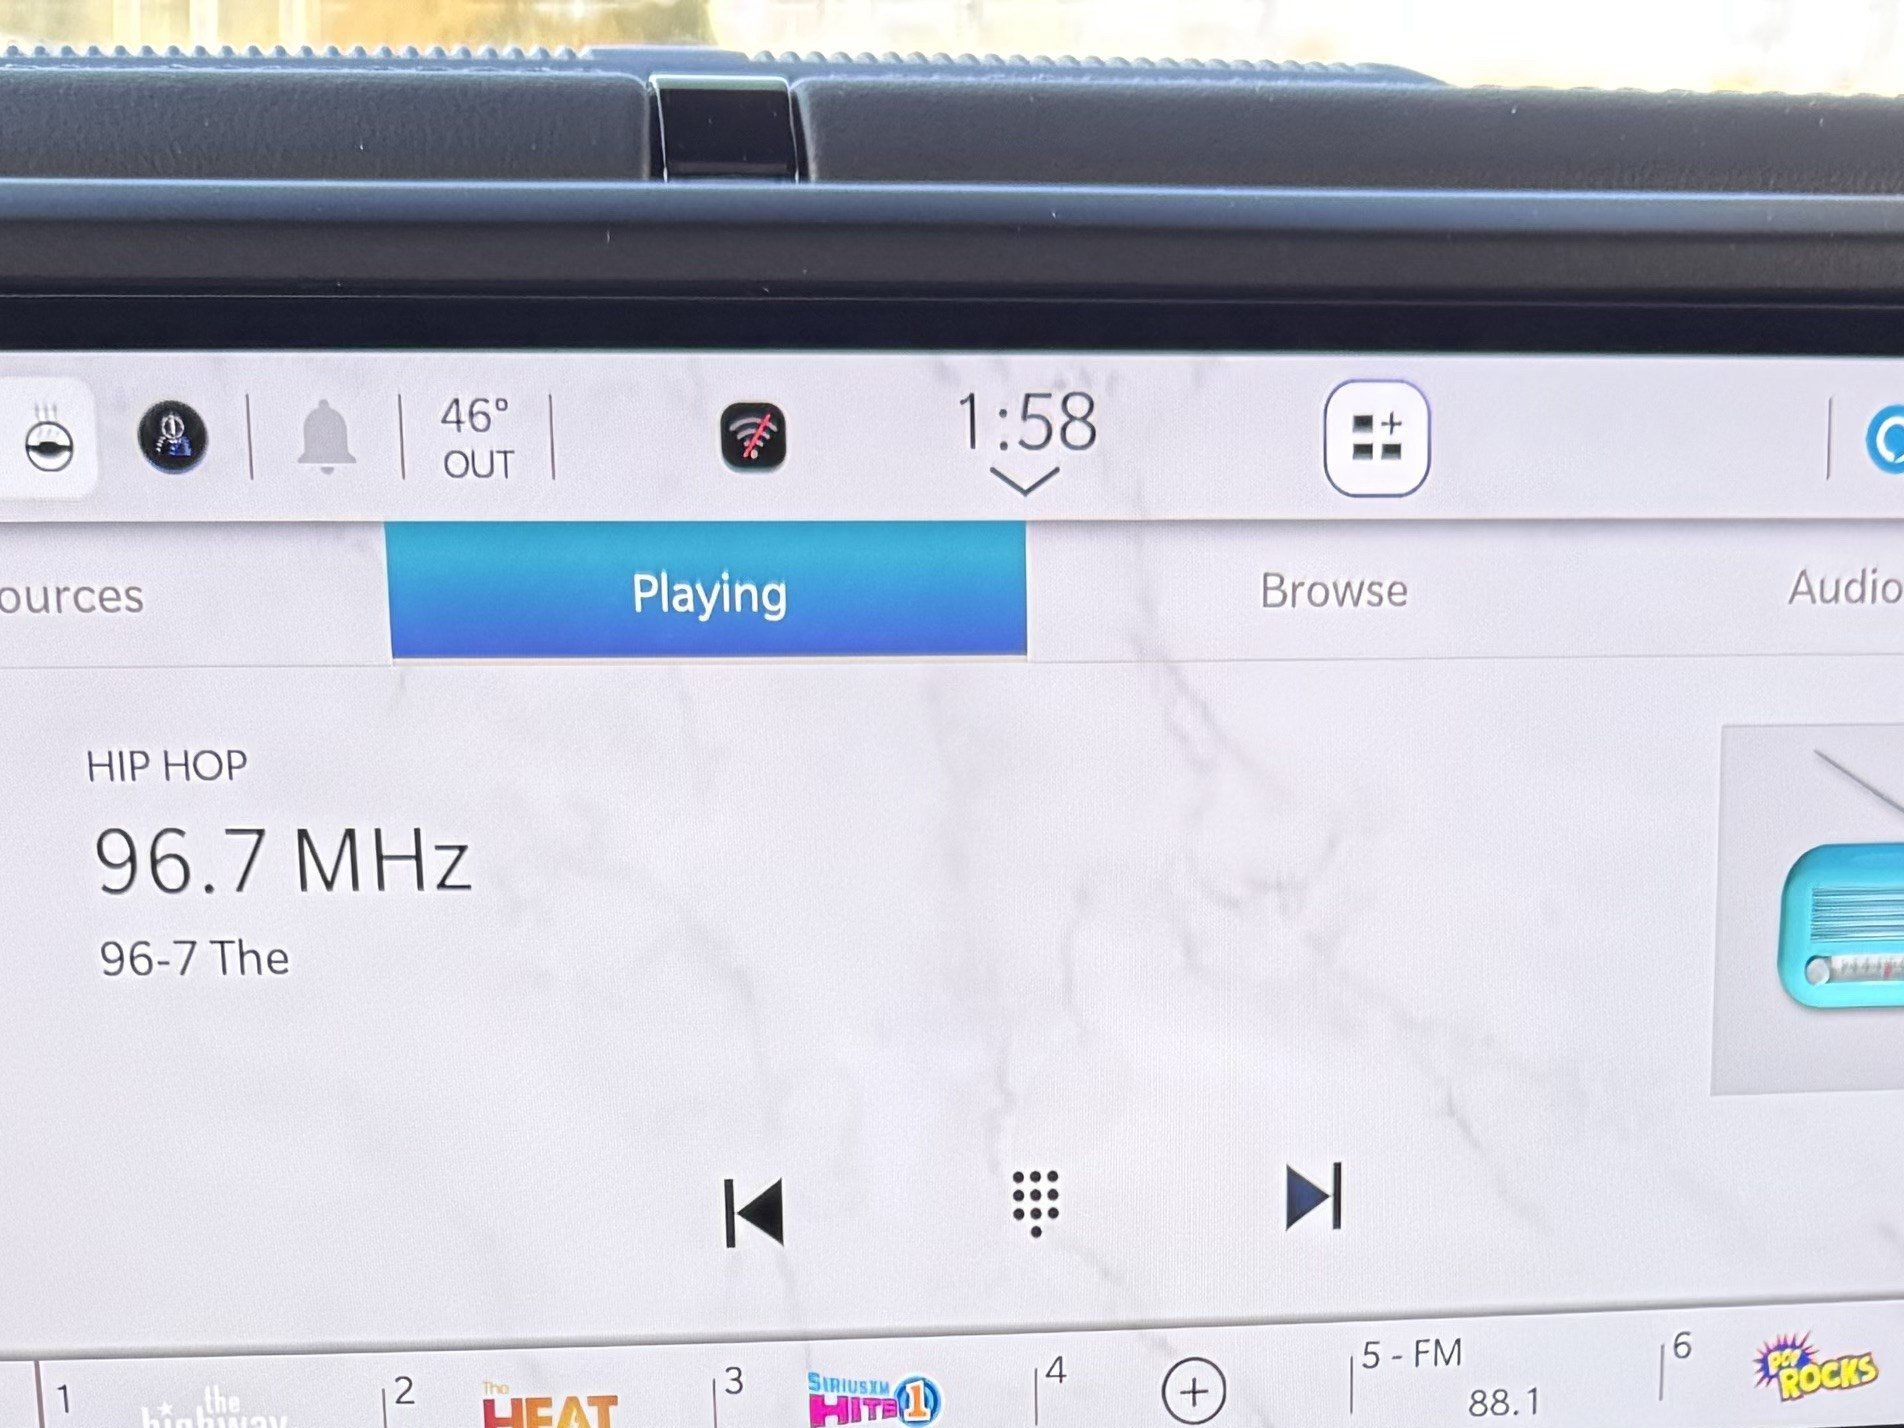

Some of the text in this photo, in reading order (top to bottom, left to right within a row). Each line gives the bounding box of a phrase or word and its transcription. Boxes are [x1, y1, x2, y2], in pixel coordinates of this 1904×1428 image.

[440, 397, 509, 434] 46°
[958, 390, 1096, 453] 1:58
[443, 449, 515, 479] OUT
[633, 570, 788, 622] Playing
[1261, 571, 1409, 609] Browse
[1788, 567, 1903, 607] Audio
[86, 748, 249, 783] HIP HOP
[95, 826, 473, 895] 96.7 MHz
[99, 938, 290, 977] 96-7 The
[1360, 1338, 1382, 1369] 5
[1412, 1336, 1463, 1369] FM
[1672, 1329, 1693, 1360] 6
[723, 1366, 744, 1396] 3
[1044, 1355, 1068, 1385] 4
[1779, 1353, 1879, 1402] ROCKS
[56, 1383, 71, 1414] 1
[203, 1384, 241, 1415] the
[394, 1375, 416, 1405] 2
[903, 1379, 932, 1422] 1
[1467, 1386, 1540, 1419] 88.1
